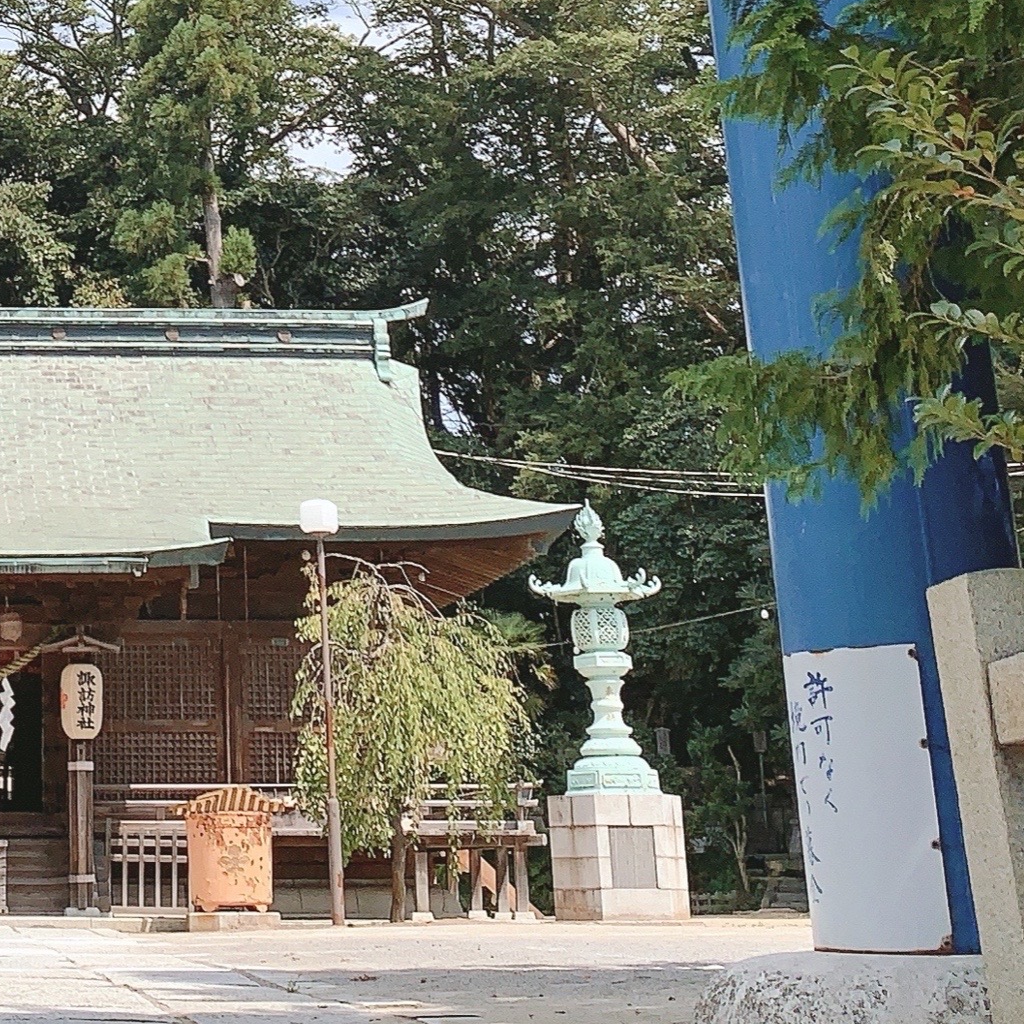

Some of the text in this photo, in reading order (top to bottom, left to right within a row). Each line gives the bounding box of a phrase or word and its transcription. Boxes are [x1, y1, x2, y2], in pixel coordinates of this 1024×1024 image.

[77, 670, 96, 730] 諏訪神社
[803, 671, 838, 814] 許可なく
